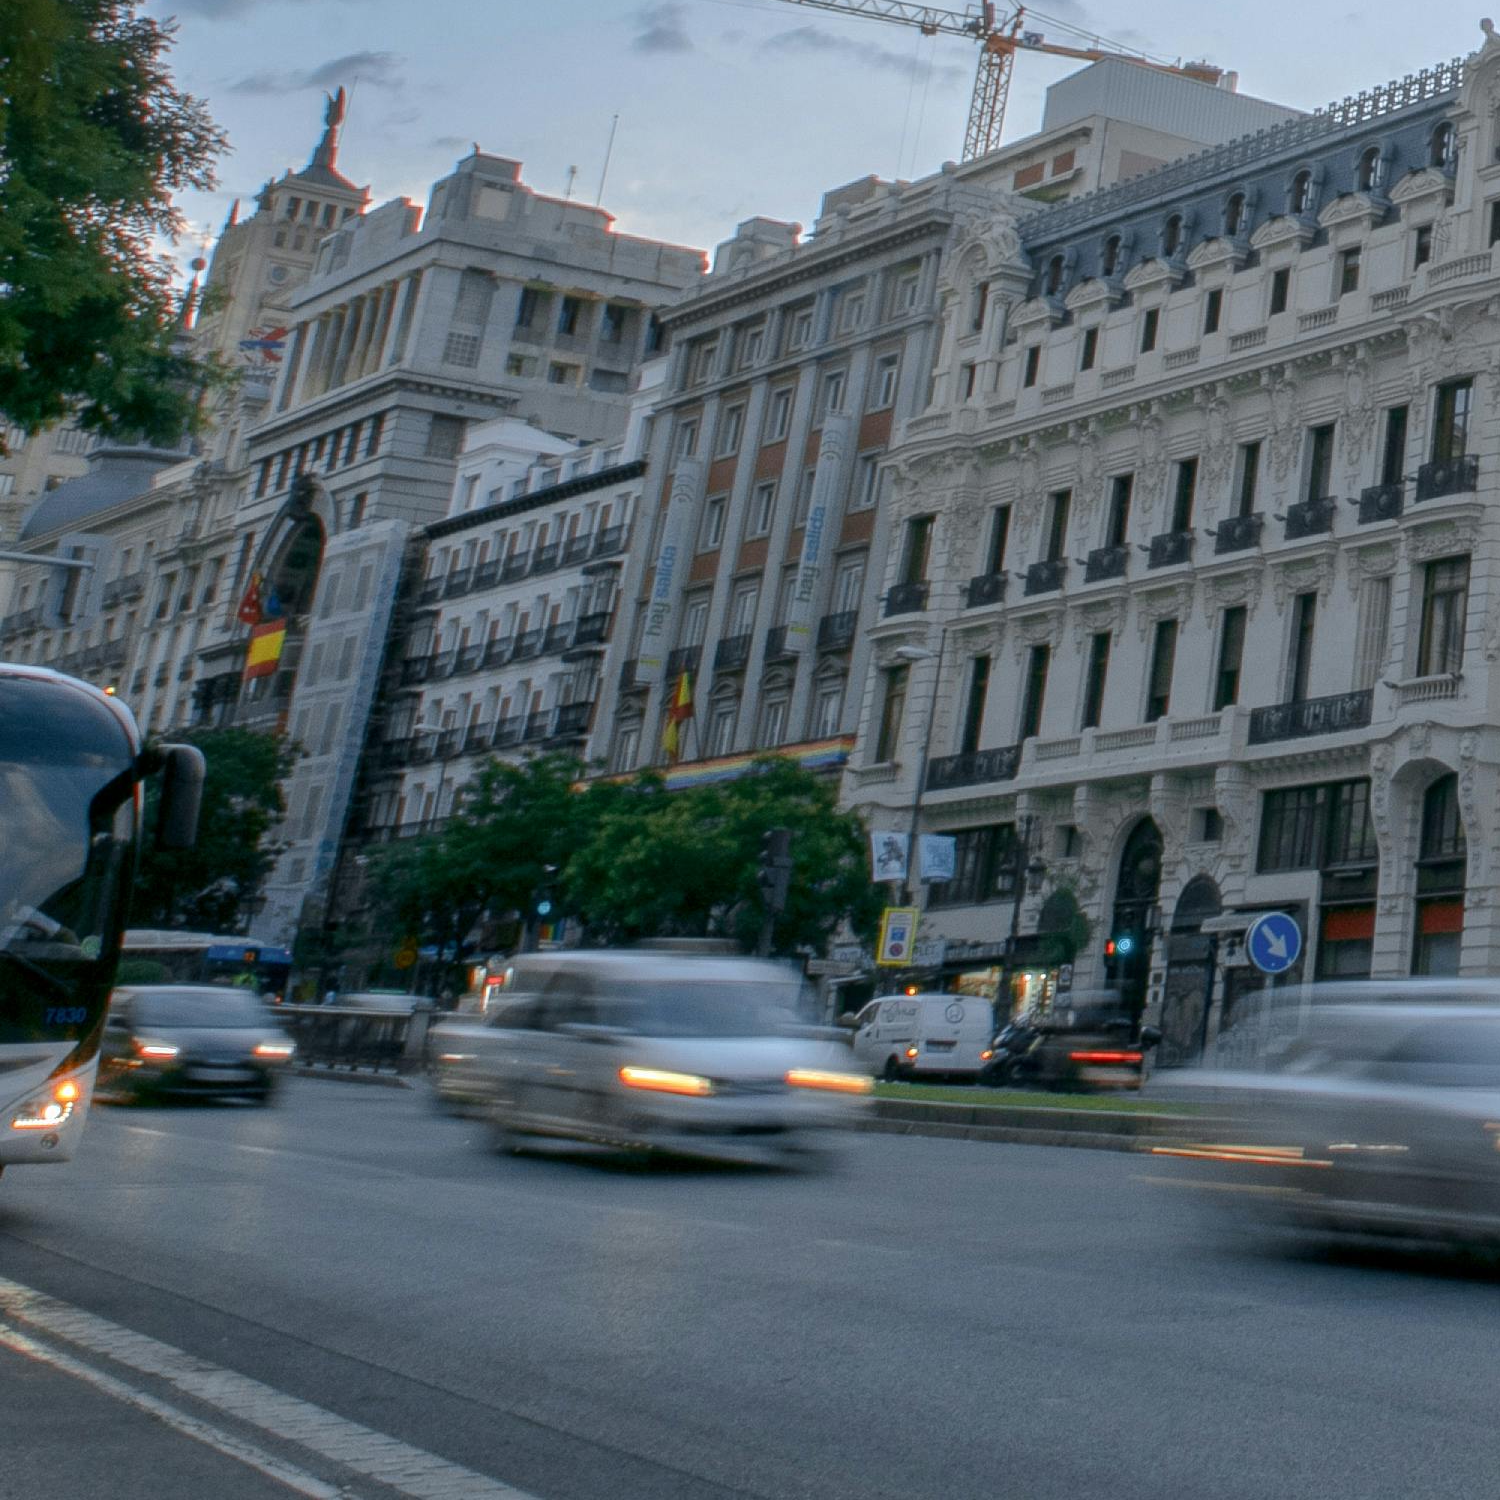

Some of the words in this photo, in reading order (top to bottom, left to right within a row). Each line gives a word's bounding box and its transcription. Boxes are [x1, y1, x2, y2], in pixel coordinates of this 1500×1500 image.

[804, 506, 826, 561] salida
[655, 545, 677, 598] salida
[796, 565, 820, 603] hay
[646, 601, 671, 637] hay
[46, 1006, 87, 1024] 7830
